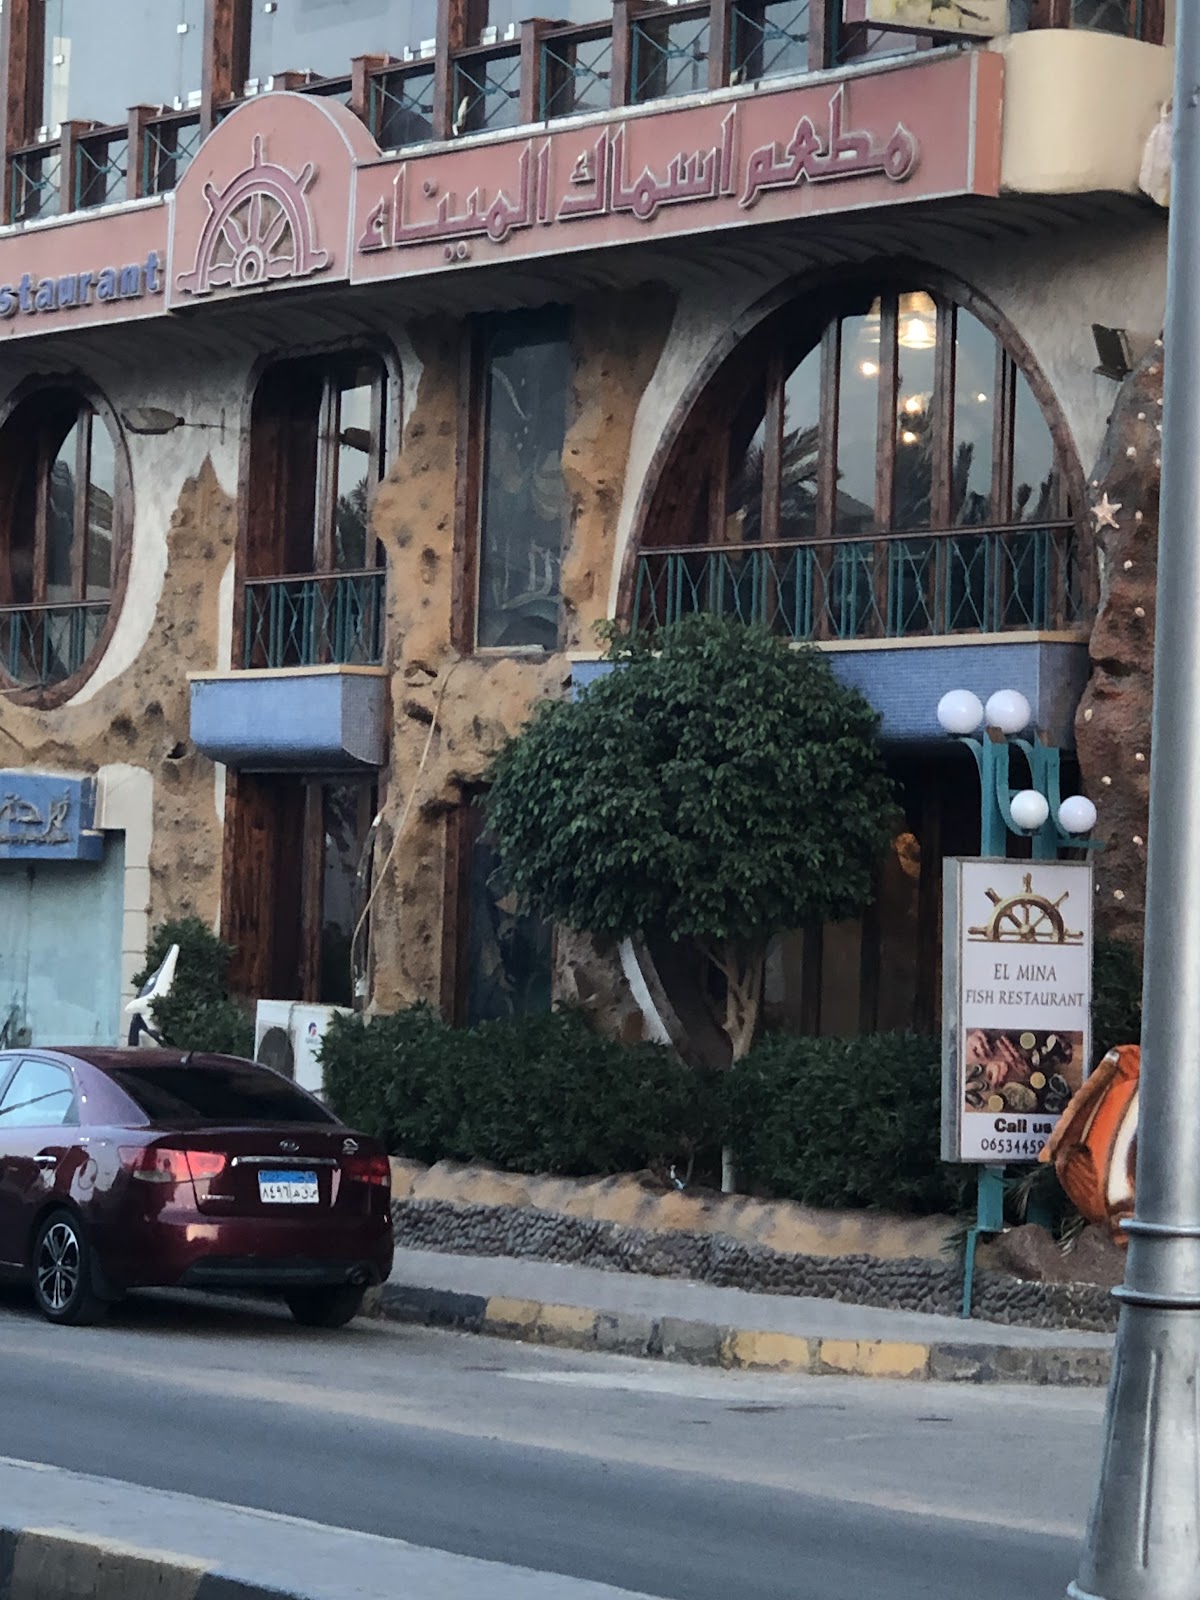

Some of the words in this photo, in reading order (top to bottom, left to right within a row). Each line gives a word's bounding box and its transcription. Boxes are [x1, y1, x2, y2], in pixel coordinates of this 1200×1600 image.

[555, 103, 738, 219] اسماك
[739, 83, 916, 208] مطعم
[358, 136, 552, 260] الميناء
[965, 989, 995, 1005] FISH
[998, 990, 1085, 1008] RESTAURANT
[994, 963, 1010, 981] EL
[1016, 964, 1058, 982] MINA
[994, 1117, 1028, 1134] Call
[1032, 1122, 1053, 1134] us
